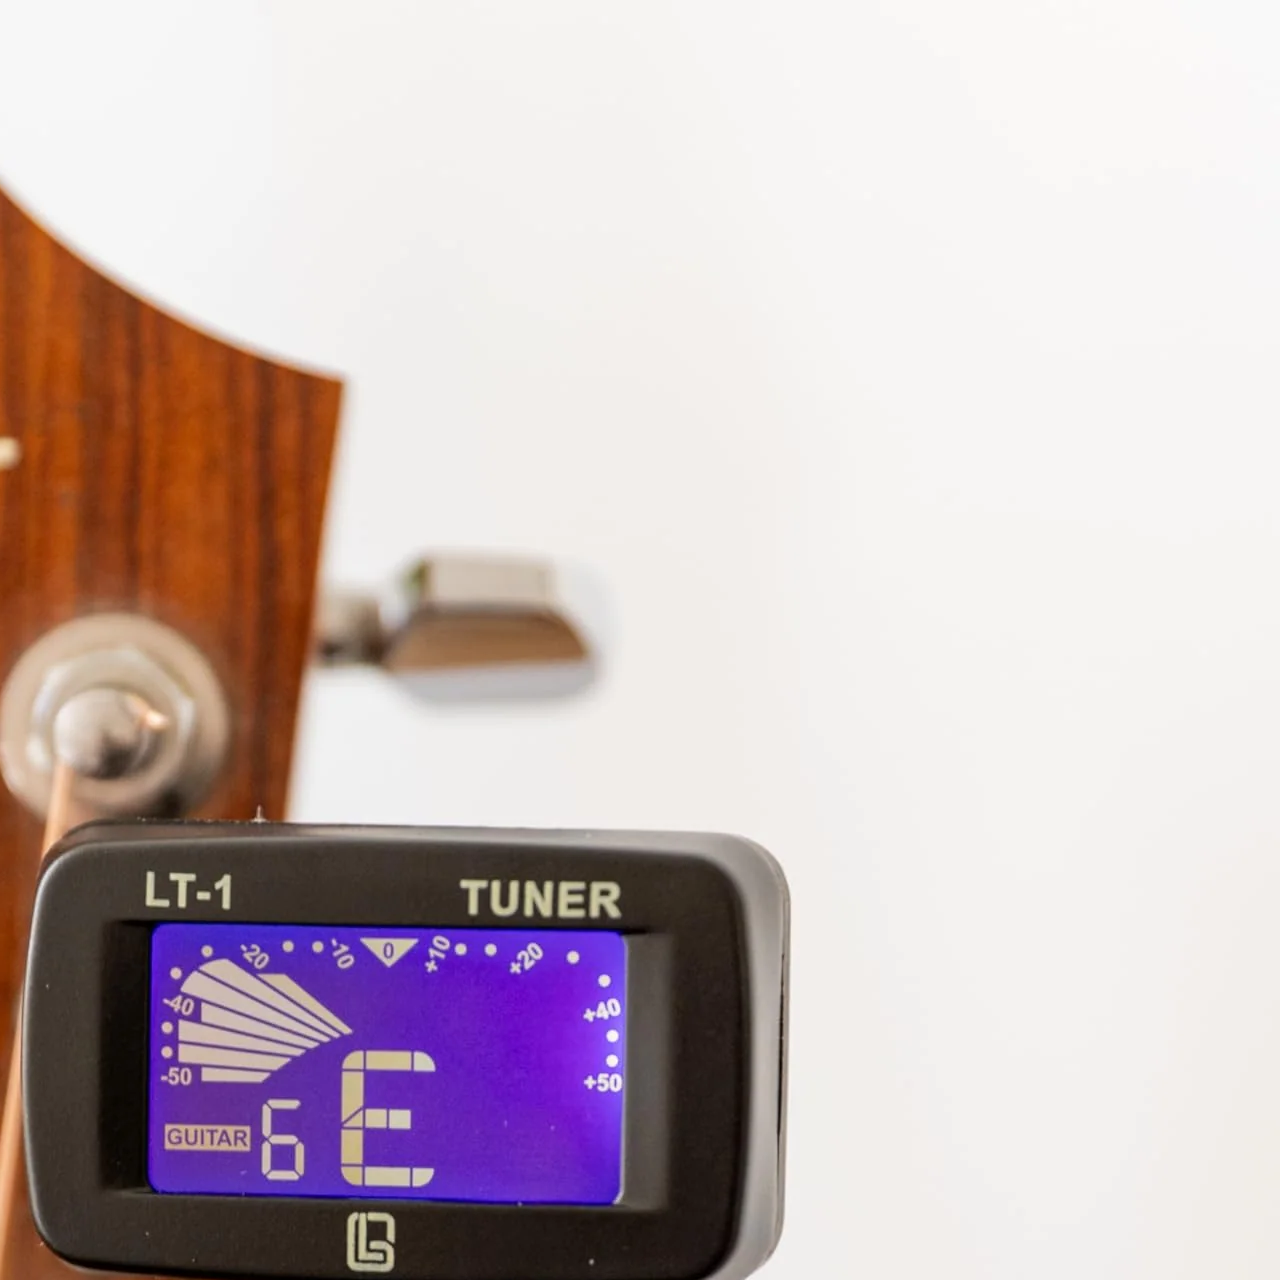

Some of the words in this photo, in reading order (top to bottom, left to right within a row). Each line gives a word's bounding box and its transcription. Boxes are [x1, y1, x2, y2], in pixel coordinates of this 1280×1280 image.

[145, 871, 232, 910] LT-1
[459, 879, 622, 918] TUNER
[240, 943, 270, 970] -20
[331, 937, 355, 969] -10
[383, 942, 394, 959] 0
[425, 935, 451, 974] +10
[509, 942, 544, 974] +20
[162, 995, 195, 1016] -40
[583, 997, 621, 1022] +40
[160, 1067, 192, 1086] -50
[583, 1072, 623, 1092] +50
[340, 1049, 436, 1188] E
[166, 1127, 249, 1148] GUITAR
[261, 1099, 305, 1181] 6
